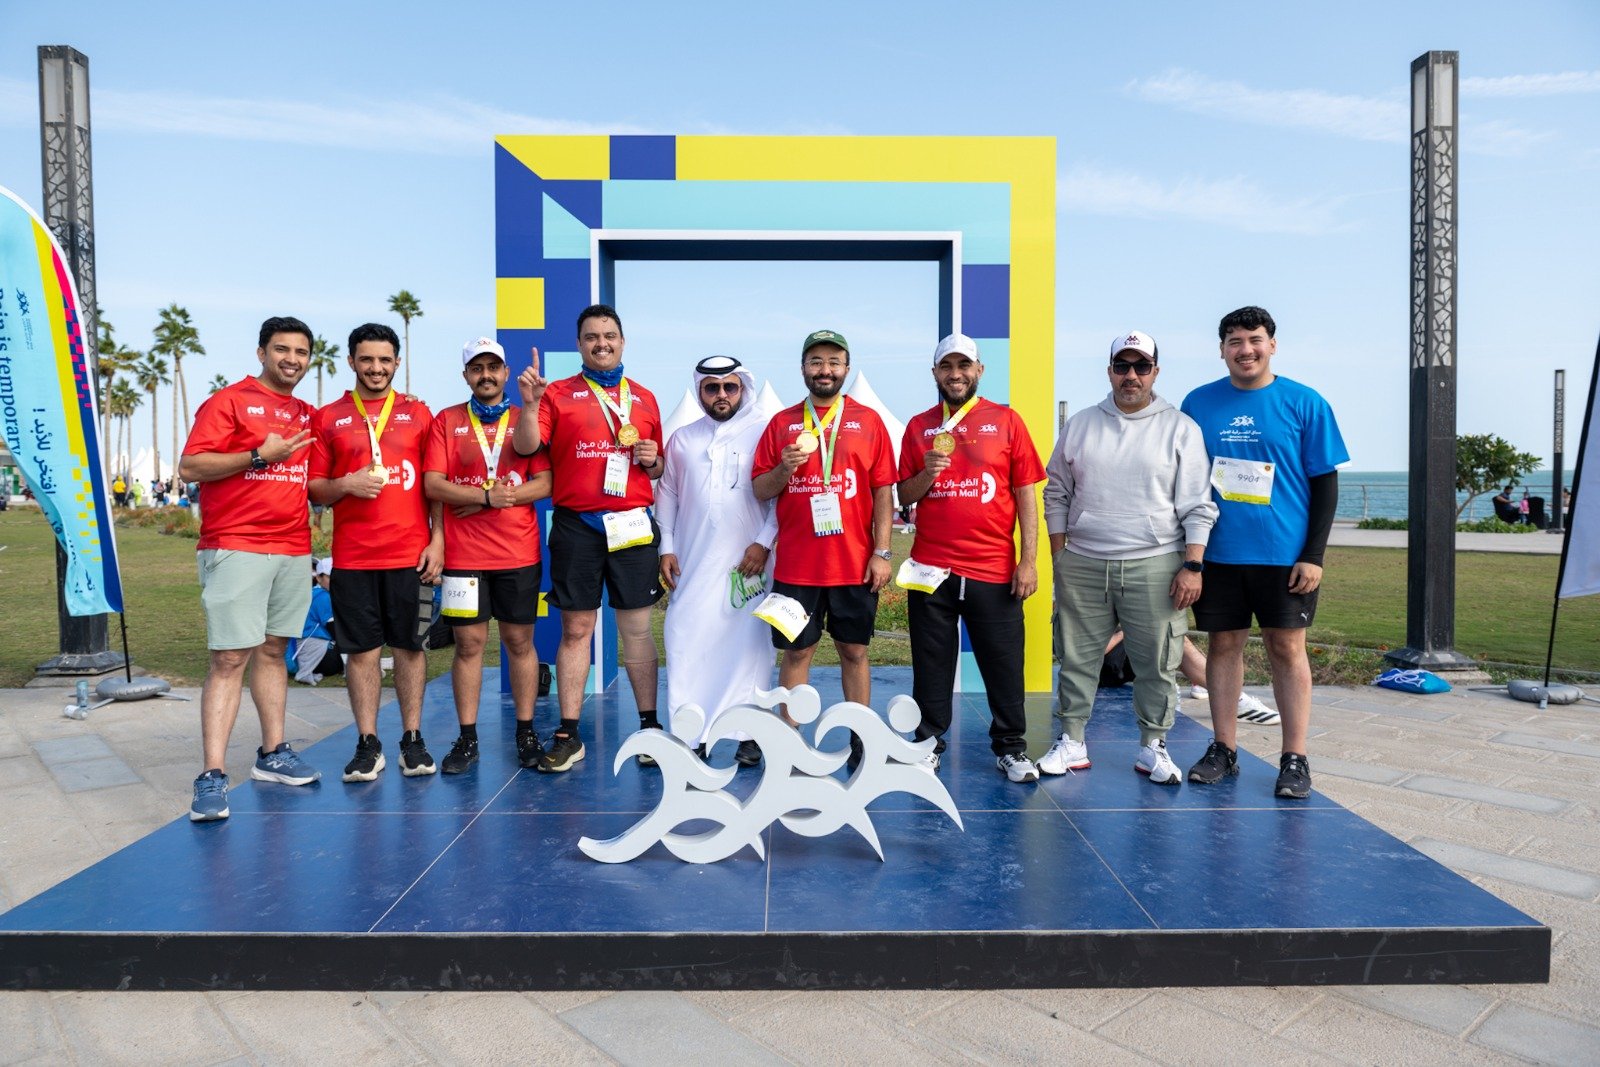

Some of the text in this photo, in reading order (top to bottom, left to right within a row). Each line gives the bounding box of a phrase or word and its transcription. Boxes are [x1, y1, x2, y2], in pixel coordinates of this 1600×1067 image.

[31, 418, 53, 451] للأبد
[576, 441, 596, 450] مول
[34, 456, 56, 494] افتخر
[245, 472, 288, 482] Dhahran
[789, 474, 843, 485] الظران مول
[1238, 474, 1260, 483] 9904
[942, 478, 979, 489] الظهران
[789, 485, 823, 493] Dhahran
[959, 489, 979, 497] Mall
